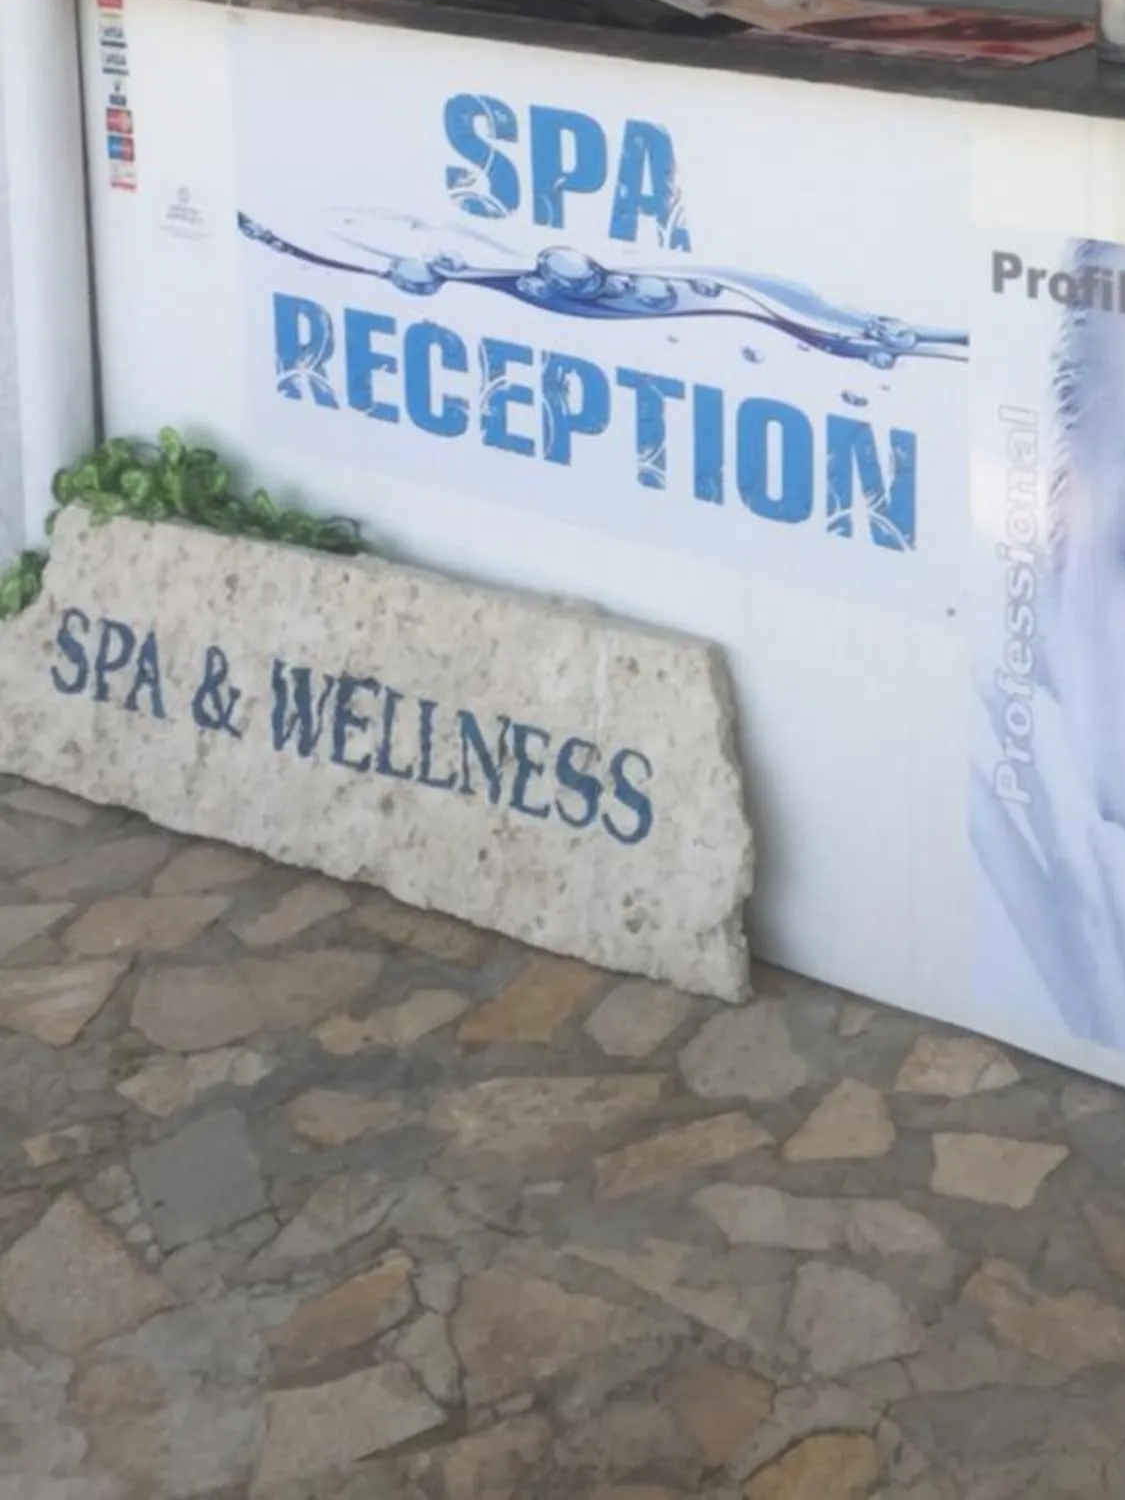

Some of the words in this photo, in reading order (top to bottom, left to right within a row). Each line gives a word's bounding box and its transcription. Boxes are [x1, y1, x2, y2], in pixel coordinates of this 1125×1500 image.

[443, 92, 692, 253] SPA
[272, 292, 917, 553] RECEPTION
[51, 608, 166, 718] SPA
[192, 646, 242, 739] &
[270, 659, 653, 845] WELLNESS
[993, 404, 1040, 806] Professional
